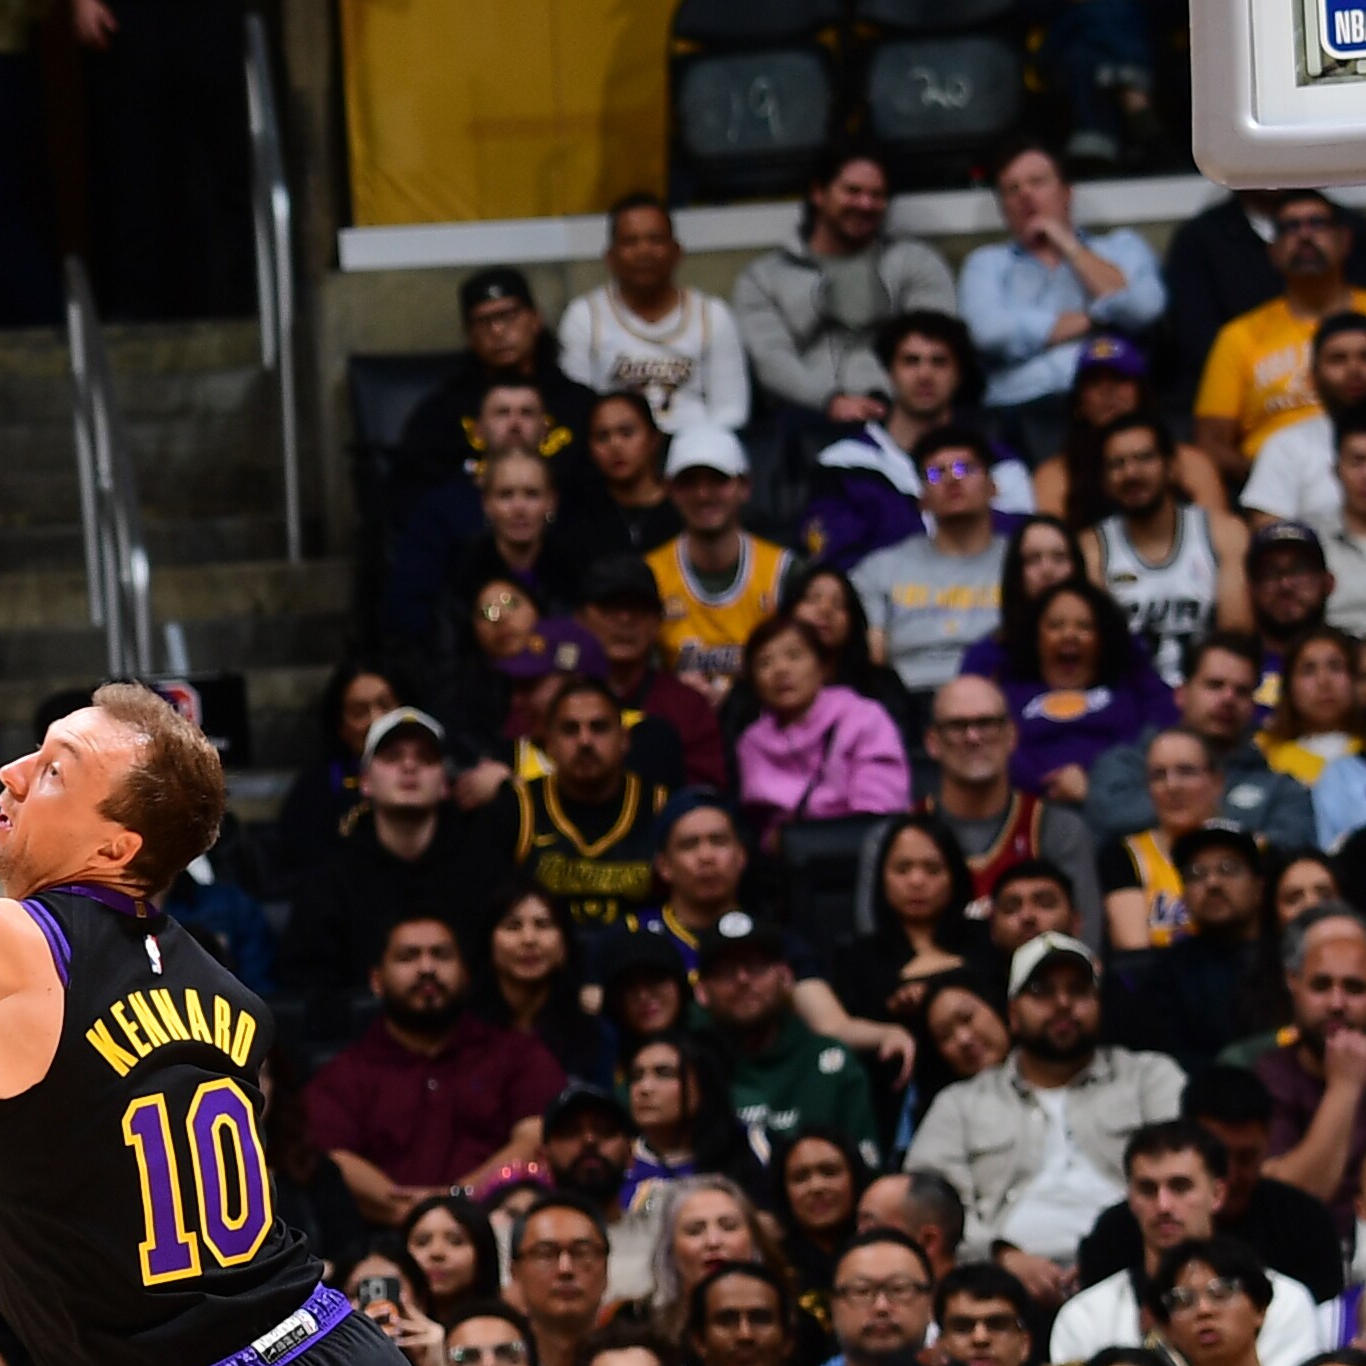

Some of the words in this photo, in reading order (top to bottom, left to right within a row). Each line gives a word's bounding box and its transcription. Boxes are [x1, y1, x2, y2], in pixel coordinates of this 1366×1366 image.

[1334, 8, 1366, 45] NB
[85, 987, 257, 1078] KENNARD
[122, 1077, 274, 1287] 10
